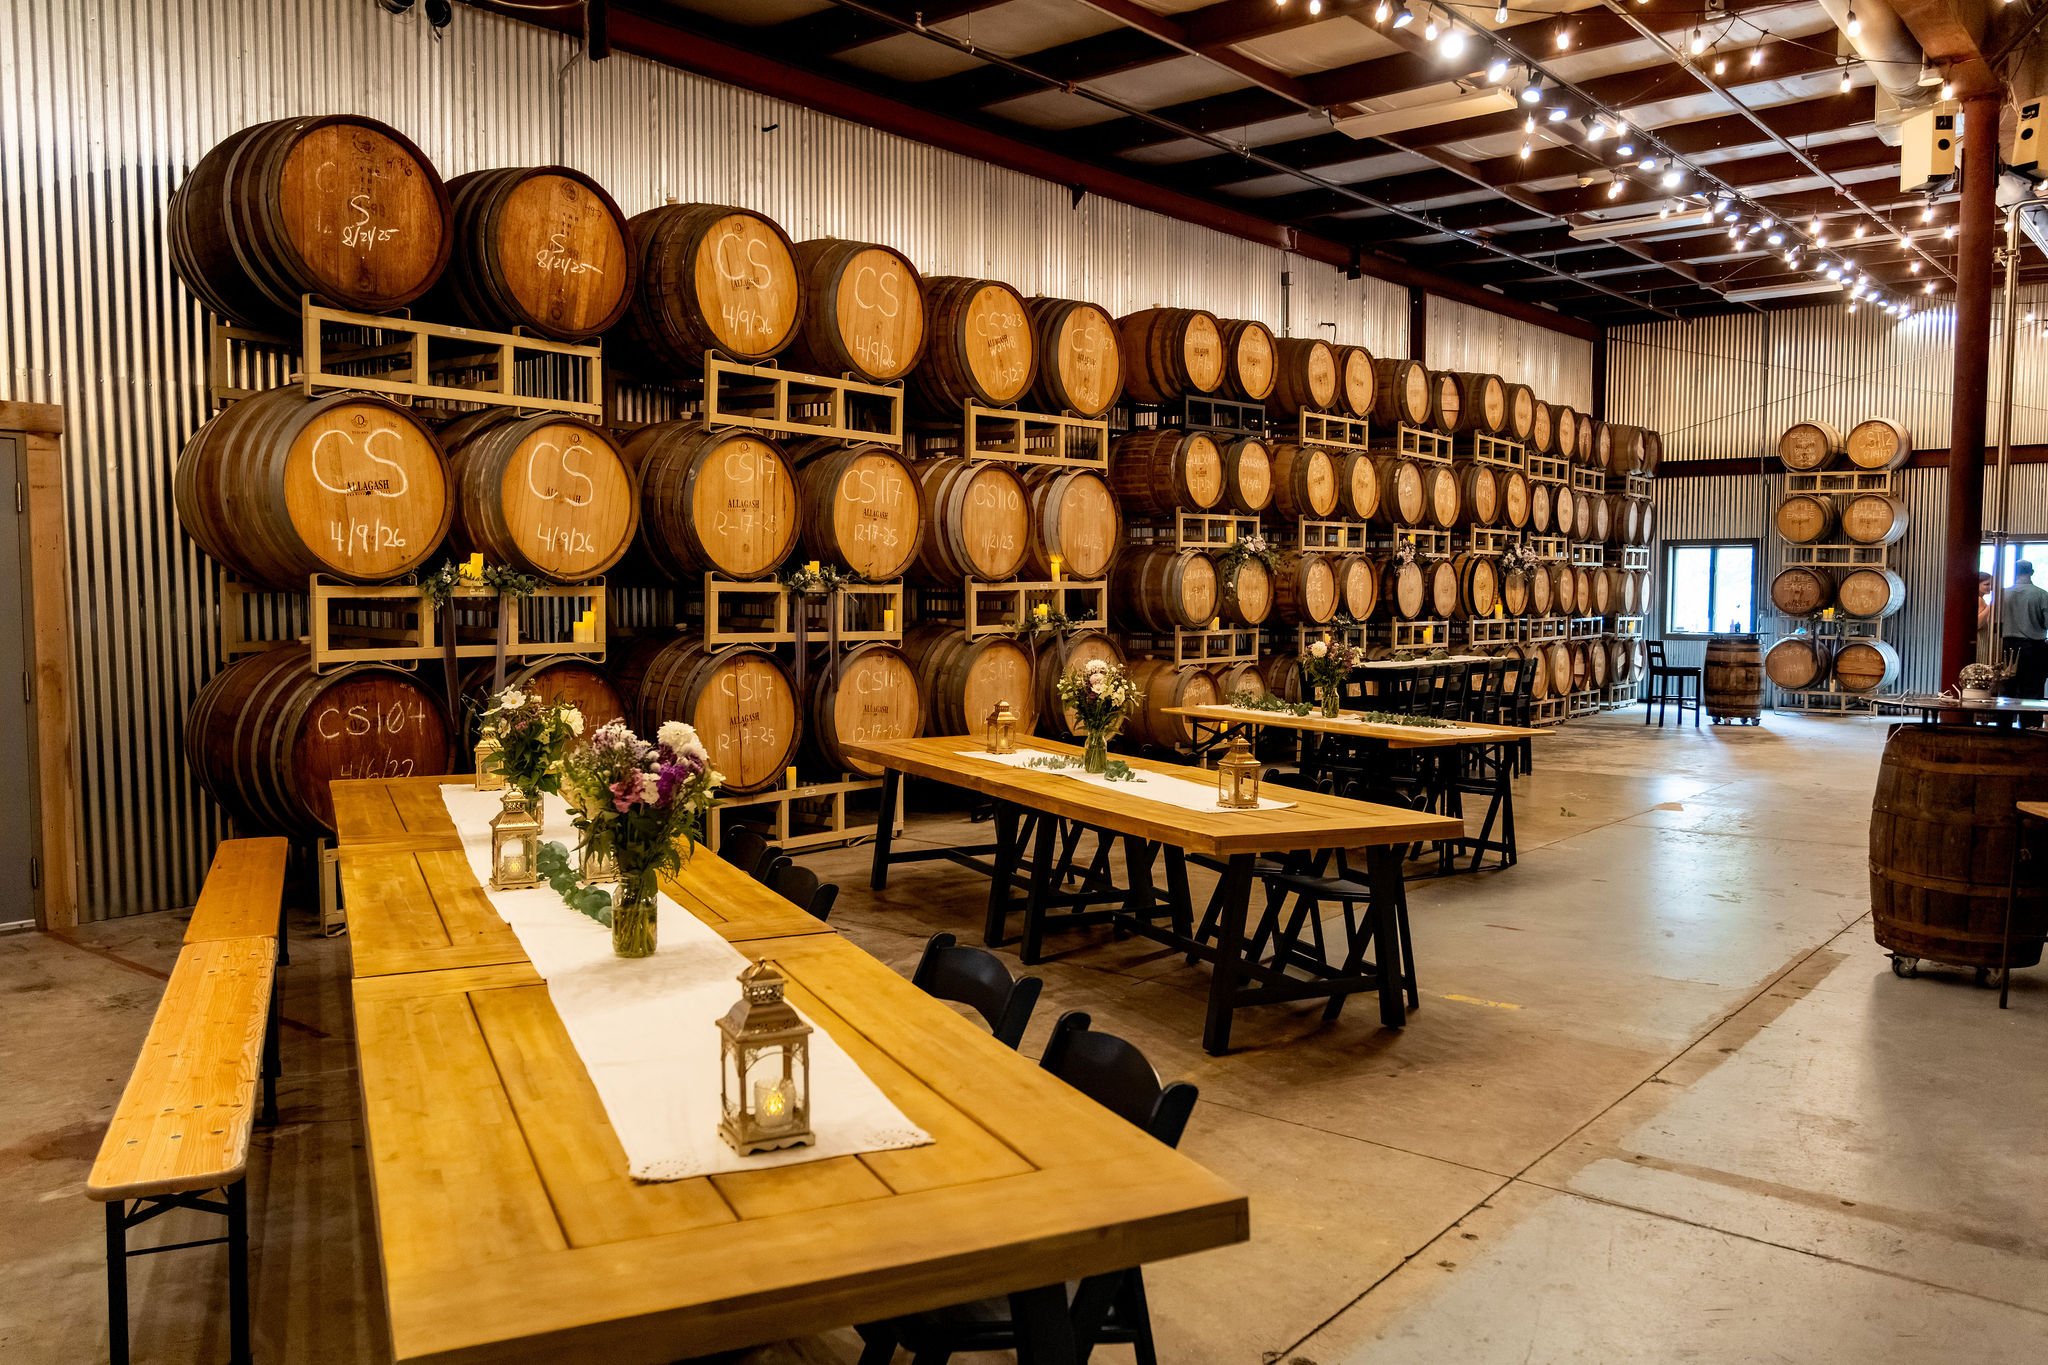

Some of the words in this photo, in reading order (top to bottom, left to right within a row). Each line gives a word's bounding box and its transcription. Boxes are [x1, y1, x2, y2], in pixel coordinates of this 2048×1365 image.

[717, 232, 773, 289] CS
[854, 265, 899, 318] CS
[722, 303, 774, 337] 4/9/26
[855, 334, 897, 369] 4/9/26
[312, 429, 408, 498] CS
[528, 441, 594, 507] CS
[724, 452, 778, 485] CS117
[346, 479, 391, 494] ALLAGASH
[842, 469, 904, 507] CS117
[973, 483, 1019, 511] CS110
[727, 498, 761, 510] ALLAGASH
[331, 517, 408, 558] 4/9/26
[537, 522, 596, 556] 4/9/26
[721, 673, 774, 702] CS117
[317, 701, 427, 739] CS104
[729, 711, 761, 727] ALLAGASH
